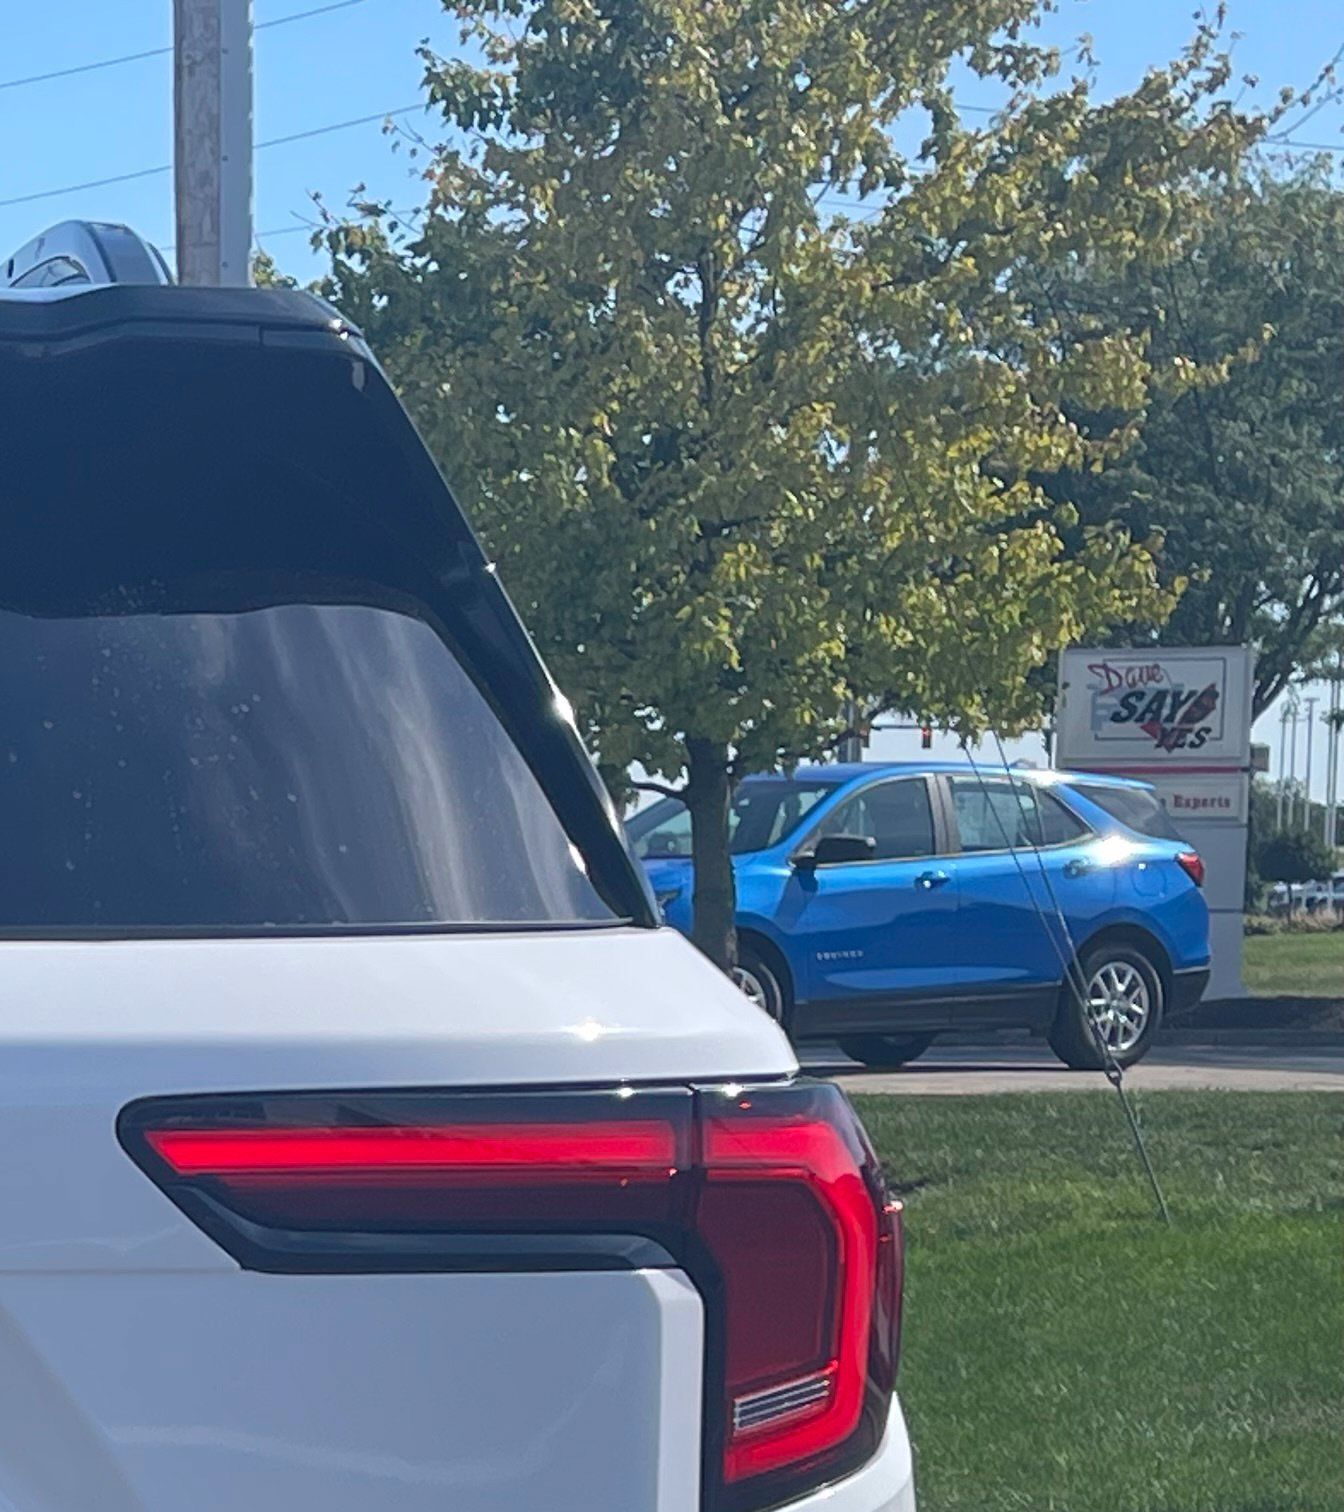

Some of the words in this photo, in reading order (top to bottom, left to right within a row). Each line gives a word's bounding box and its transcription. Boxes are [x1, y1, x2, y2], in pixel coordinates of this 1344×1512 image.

[1087, 662, 1165, 696] Dave
[1109, 689, 1200, 724] SAY
[1154, 726, 1214, 748] YES
[1173, 794, 1231, 810] Experts
